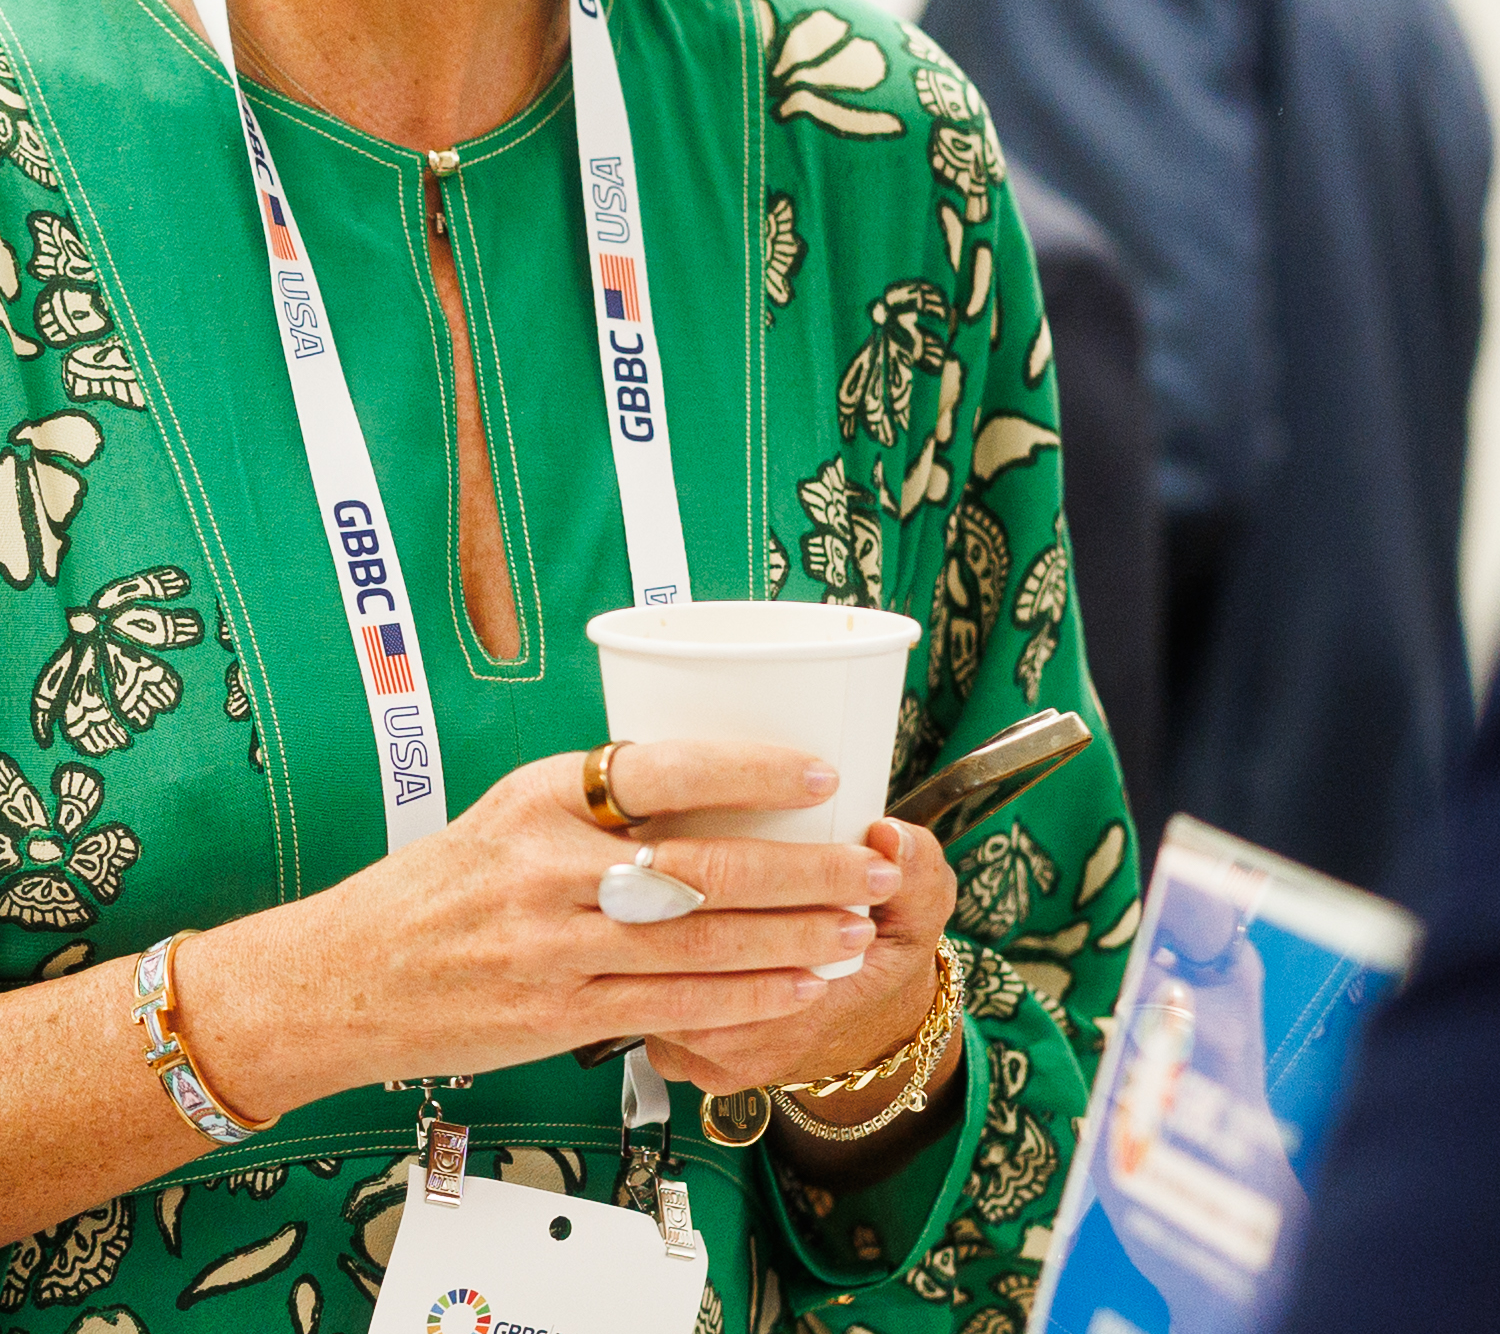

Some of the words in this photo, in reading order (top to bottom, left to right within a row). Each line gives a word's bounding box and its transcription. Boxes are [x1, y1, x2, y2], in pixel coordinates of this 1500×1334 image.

[239, 89, 274, 187] BBC
[590, 156, 630, 245] USA
[277, 270, 325, 359] USA
[609, 330, 654, 443] GBBC
[333, 499, 395, 615] GBBC
[383, 705, 432, 806] USA
